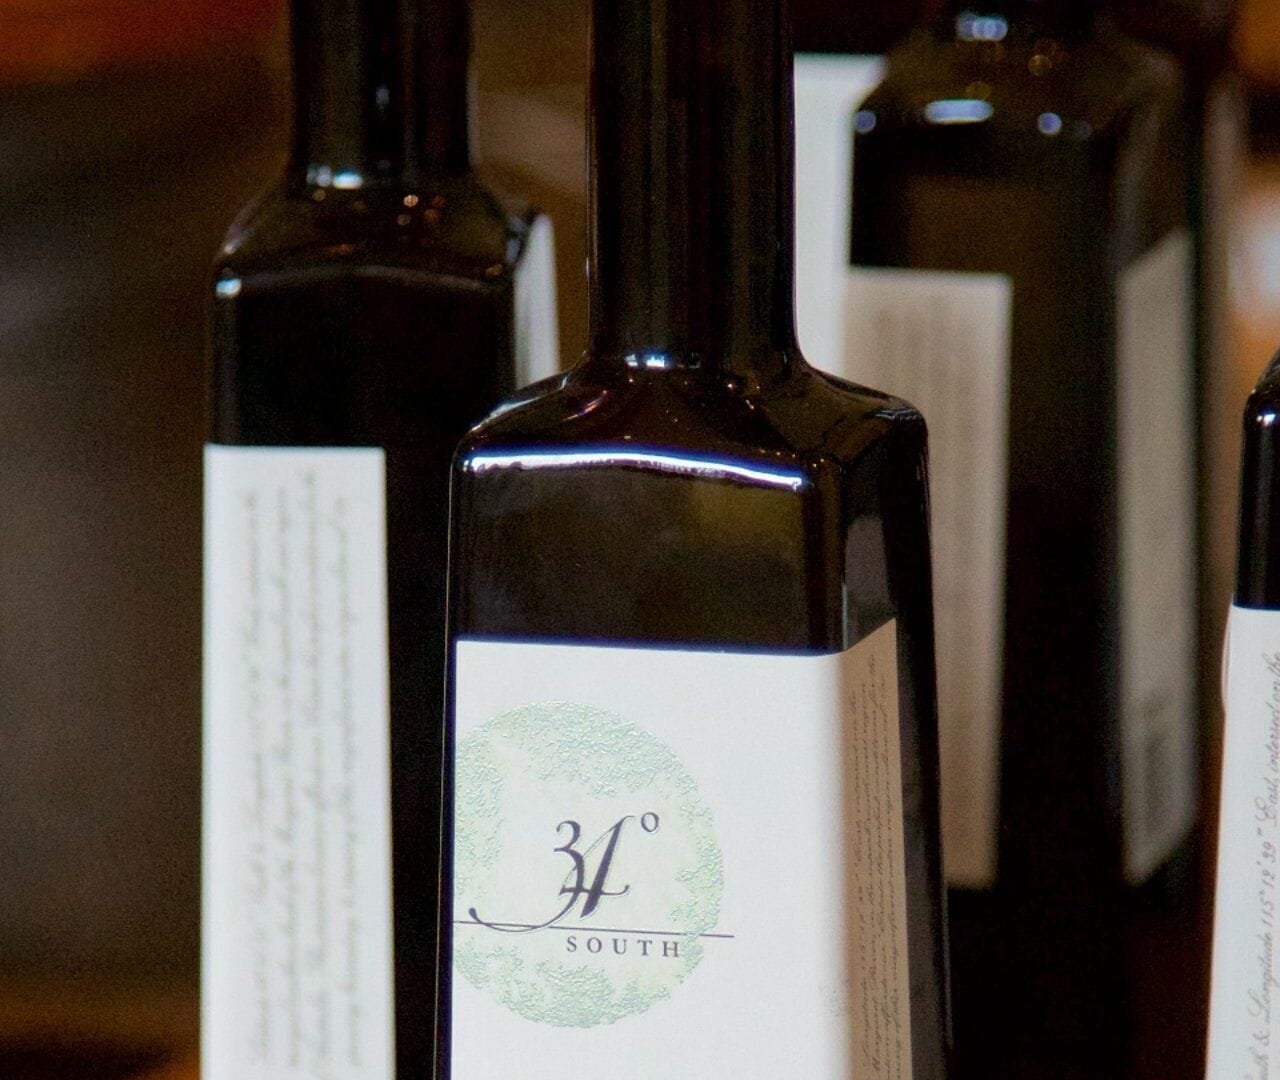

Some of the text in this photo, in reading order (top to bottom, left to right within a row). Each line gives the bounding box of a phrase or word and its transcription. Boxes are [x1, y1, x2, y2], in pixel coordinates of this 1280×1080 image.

[1265, 702, 1280, 773] intersect
[566, 935, 680, 958] SOUTH
[1247, 932, 1280, 1025] Longitude
[1251, 1029, 1270, 1047] &
